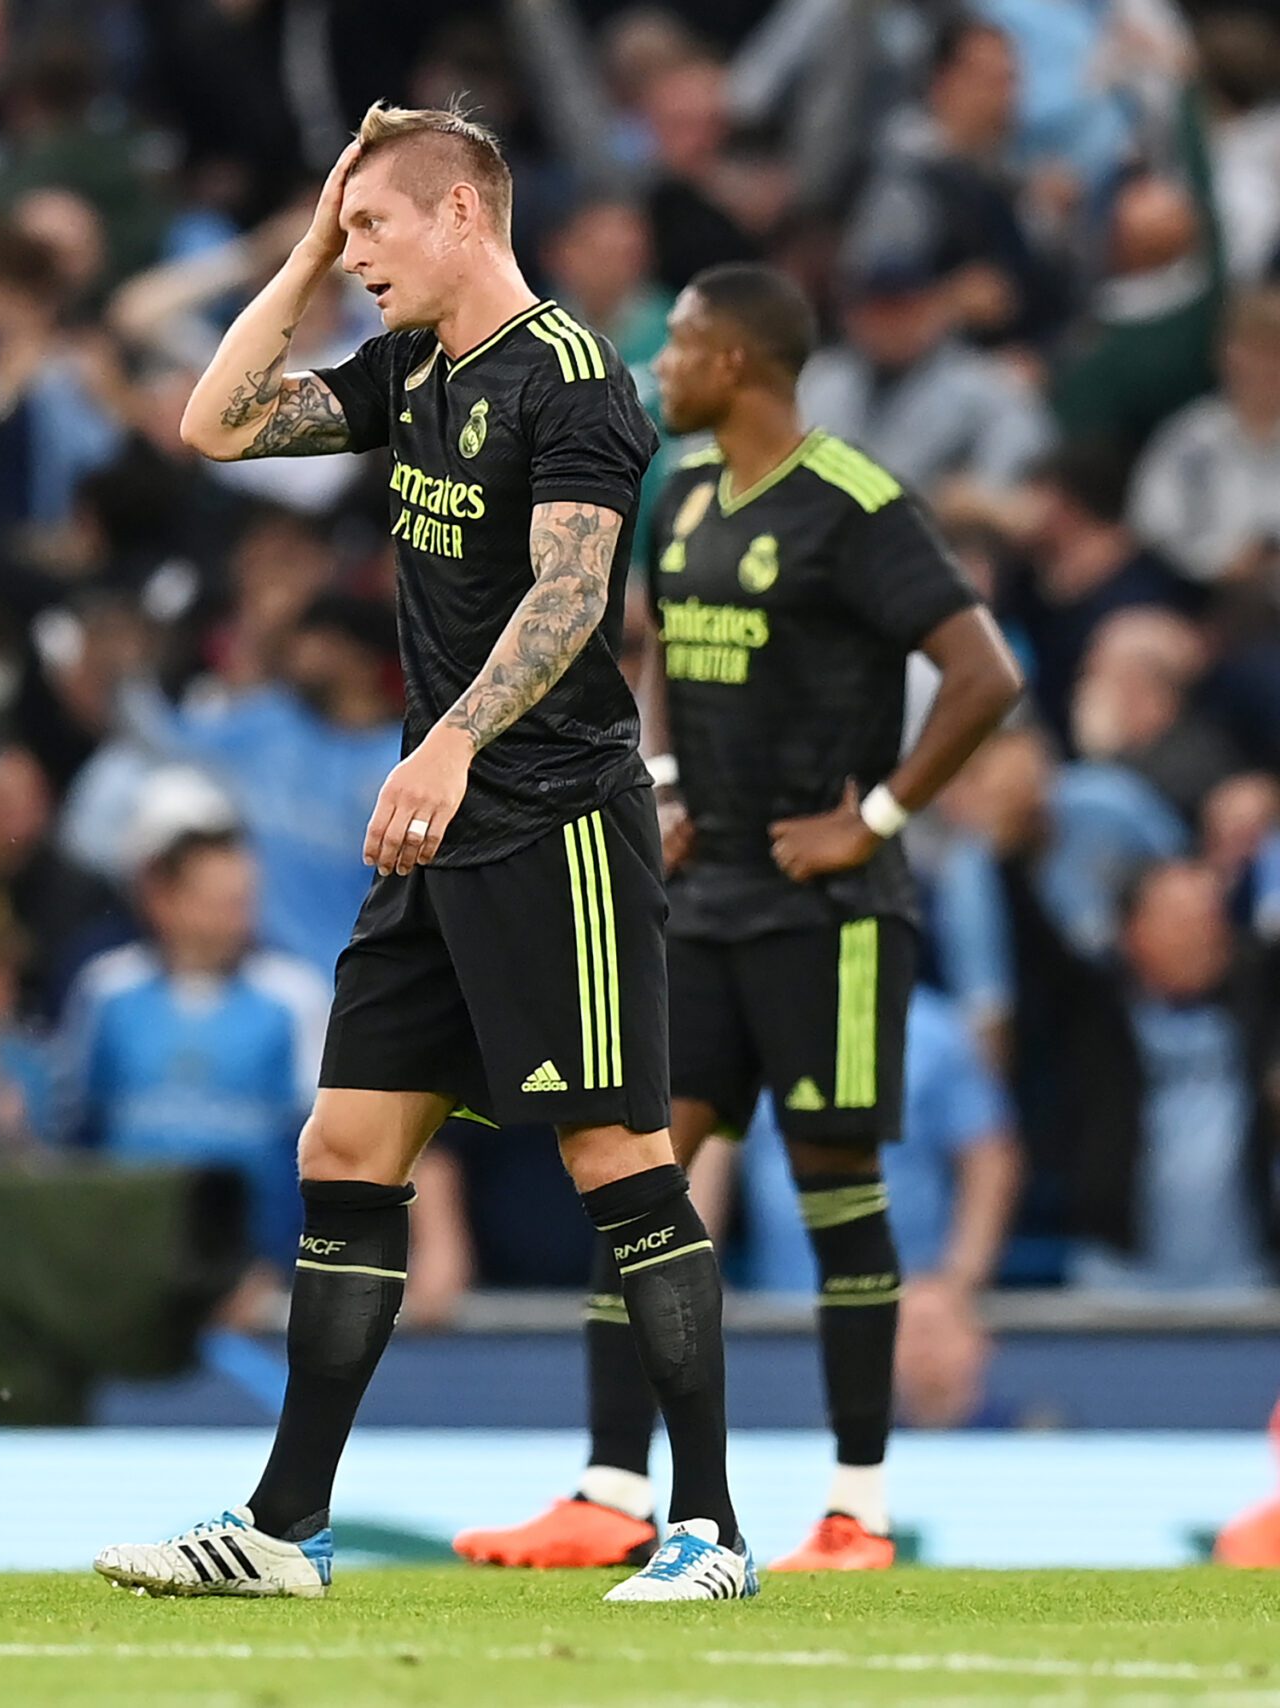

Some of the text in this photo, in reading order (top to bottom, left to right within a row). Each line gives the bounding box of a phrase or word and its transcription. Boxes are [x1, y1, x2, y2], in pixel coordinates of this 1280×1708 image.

[389, 449, 486, 519] mrates
[412, 514, 463, 559] BETTER
[521, 1079, 568, 1092] adidas
[299, 1233, 347, 1255] MCF
[613, 1225, 676, 1261] RMCF
